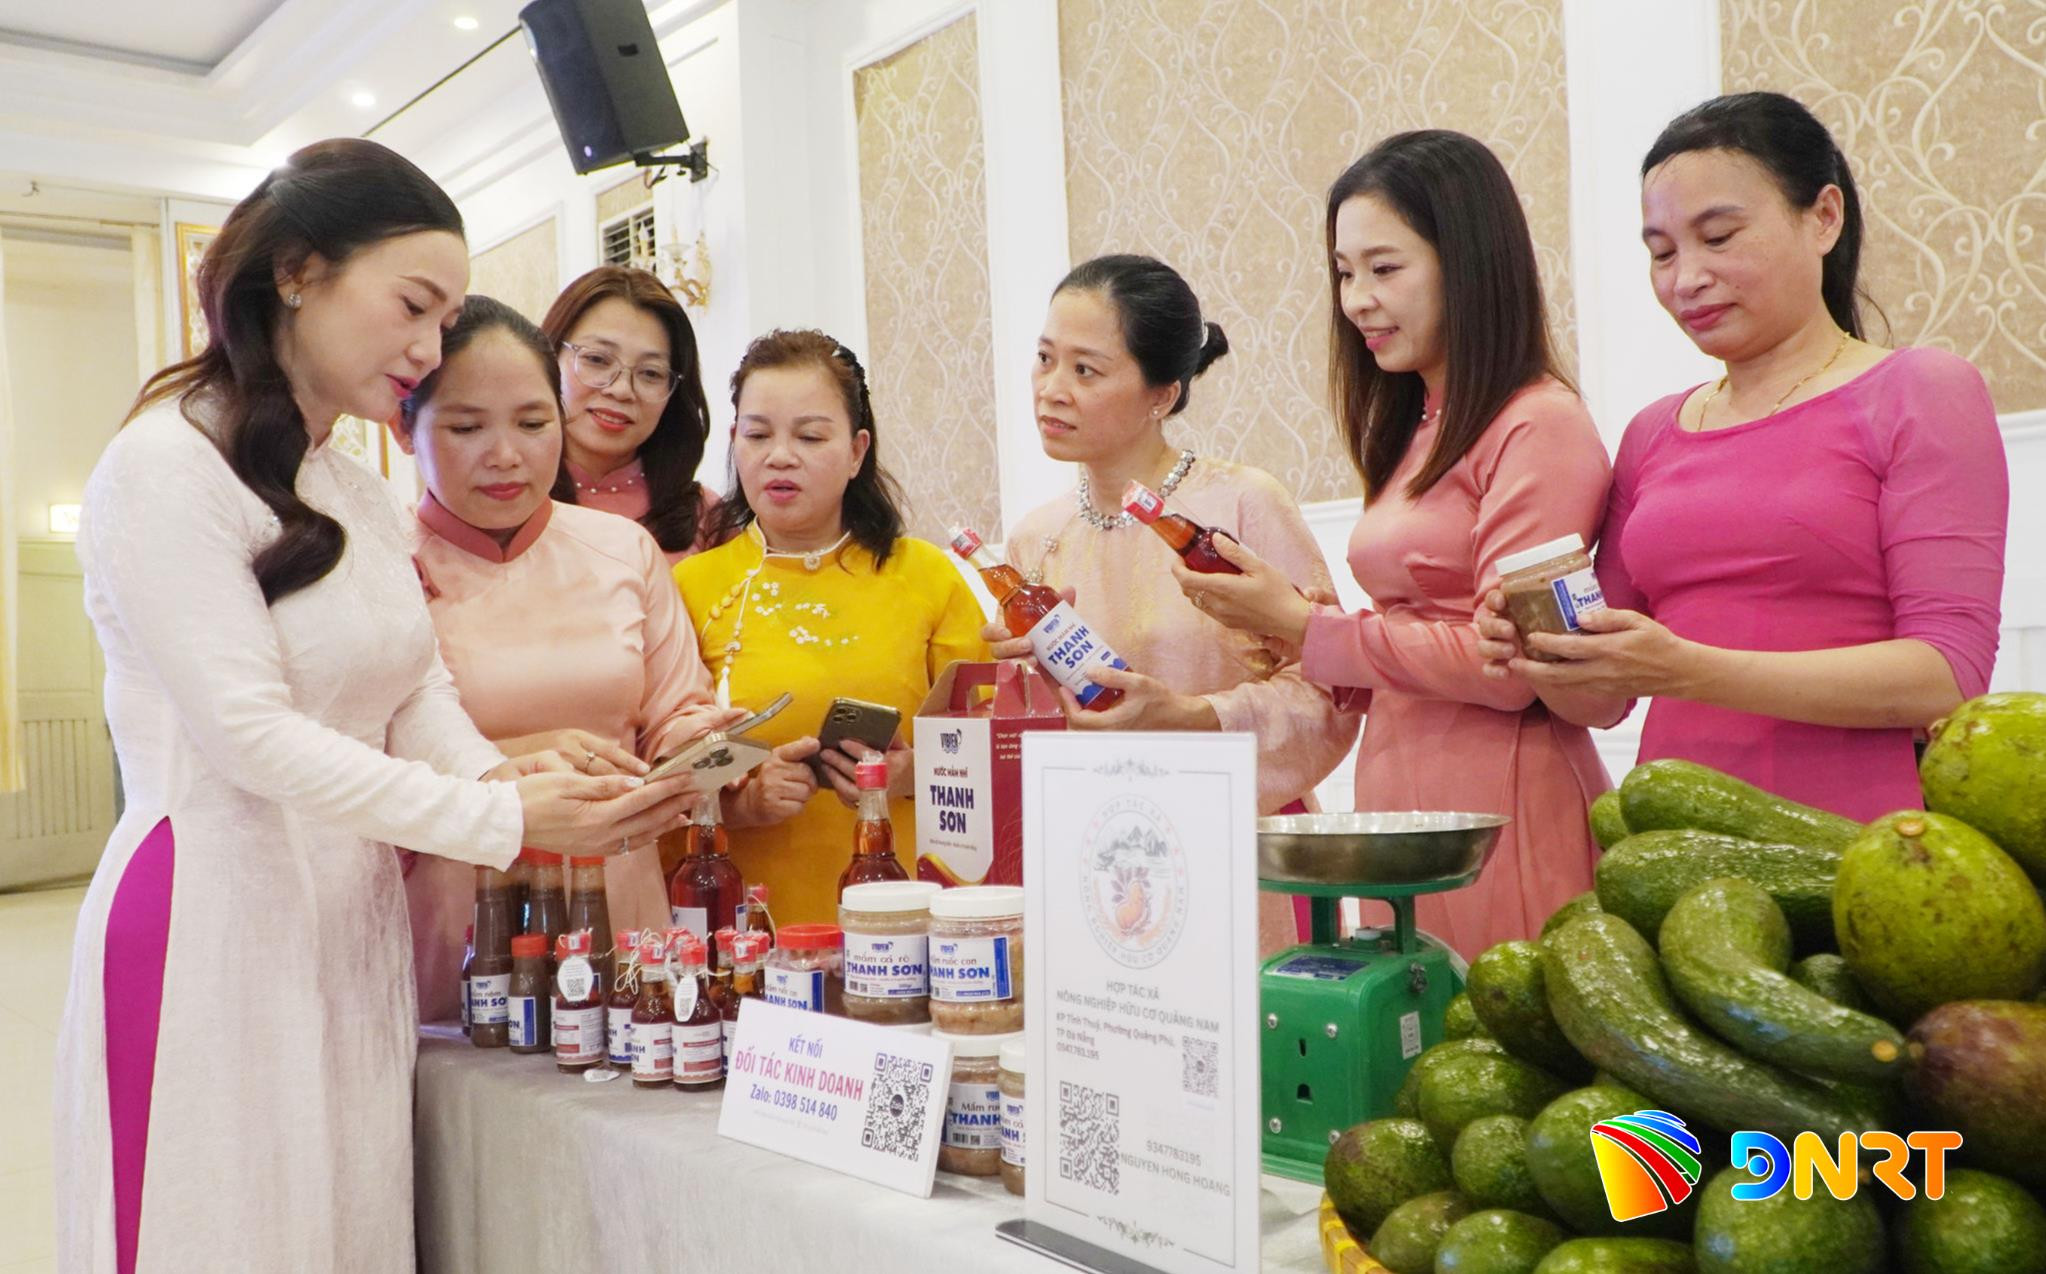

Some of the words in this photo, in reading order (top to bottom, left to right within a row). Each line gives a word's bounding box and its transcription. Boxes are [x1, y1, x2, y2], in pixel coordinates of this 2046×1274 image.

[1048, 625, 1090, 665] THANH
[930, 784, 974, 810] THANH
[846, 960, 888, 976] THANH
[1127, 982, 1146, 999] TÁC
[1056, 989, 1082, 1006] NÔNG
[1158, 1009, 1194, 1029] QUẢNG
[1195, 1017, 1220, 1033] NAM
[788, 1034, 806, 1054] KẾT
[807, 1038, 823, 1059] NỐI
[735, 1045, 756, 1073] ĐỐI
[760, 1051, 782, 1080] TÁC
[784, 1062, 816, 1089] KINH
[818, 1070, 864, 1102] DOANH
[750, 1083, 772, 1103] Zalo:
[773, 1089, 798, 1110] 0398
[799, 1096, 817, 1116] 514
[818, 1101, 838, 1122] 840
[1120, 1152, 1160, 1174] NGUYEN
[1161, 1165, 1191, 1185] HONG
[1193, 1176, 1231, 1197] HOANG
